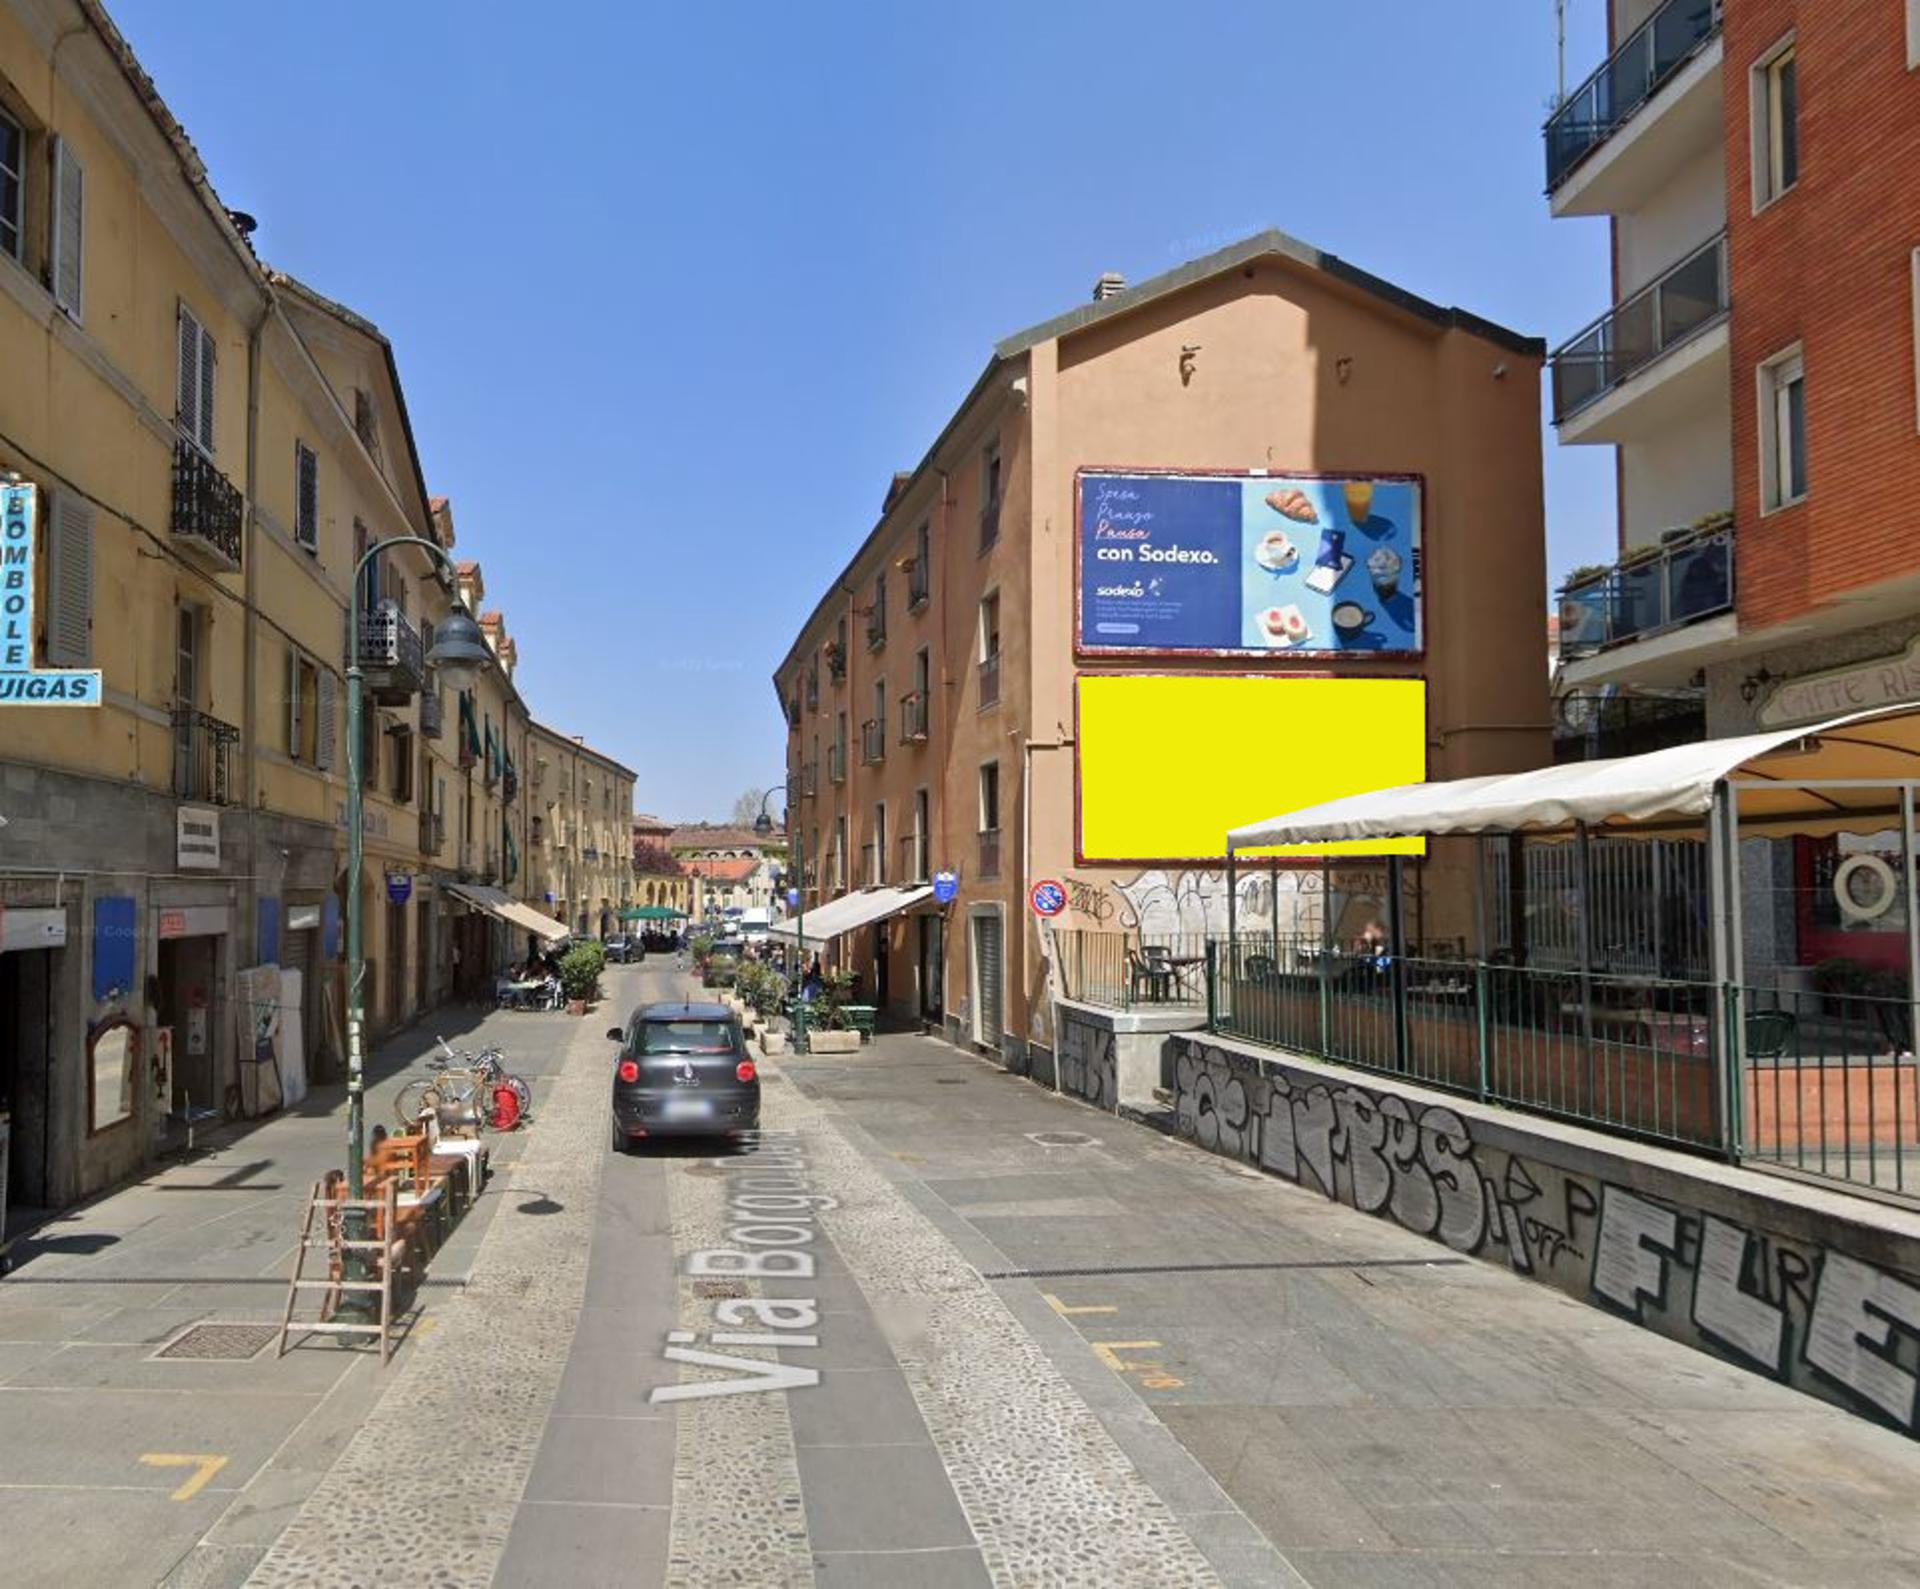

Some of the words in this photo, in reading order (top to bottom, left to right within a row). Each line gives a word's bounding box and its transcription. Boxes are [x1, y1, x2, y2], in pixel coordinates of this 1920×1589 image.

[5, 496, 28, 664] BOMBOLE
[1097, 547, 1133, 561] con
[1139, 543, 1219, 564] Sodexo.
